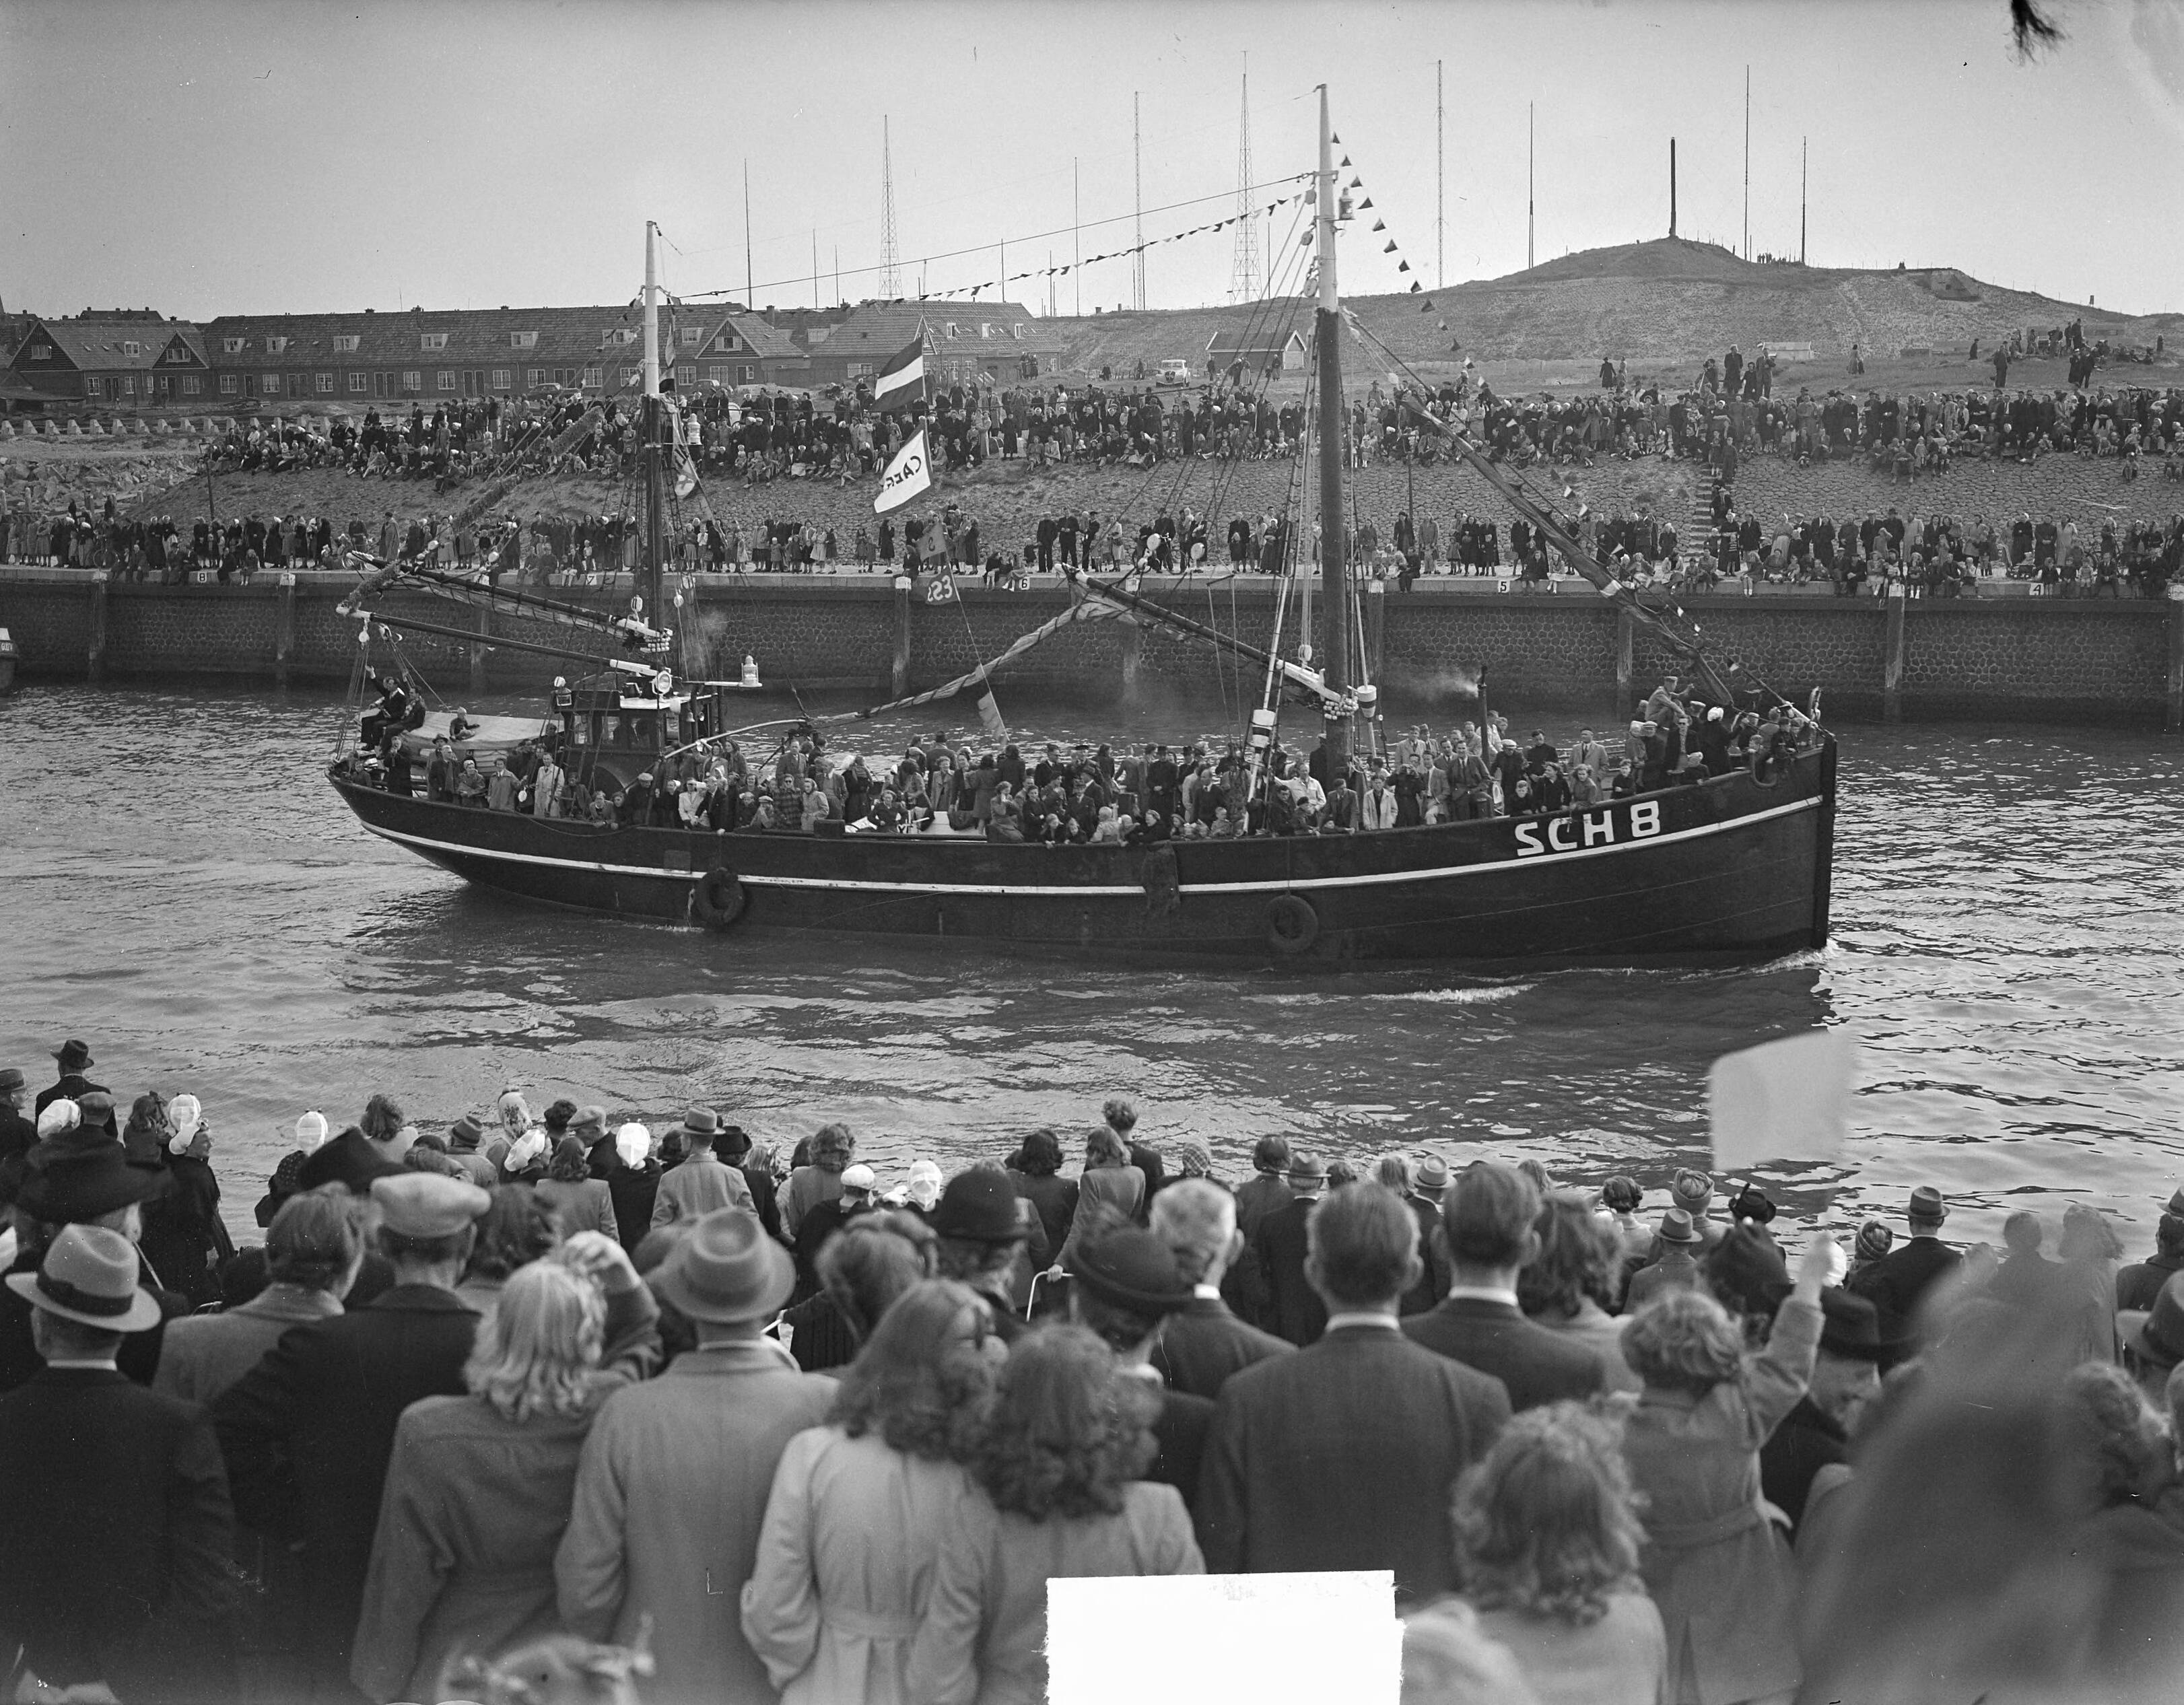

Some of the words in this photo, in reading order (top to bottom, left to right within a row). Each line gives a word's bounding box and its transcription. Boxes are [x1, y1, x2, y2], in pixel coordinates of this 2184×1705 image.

[199, 573, 205, 582] 8
[588, 576, 595, 584] 7
[1022, 578, 1027, 588] 6
[1501, 581, 1507, 592] 5
[2033, 584, 2041, 595] 4
[1515, 810, 1614, 856] SCH
[1631, 800, 1661, 837] 8
